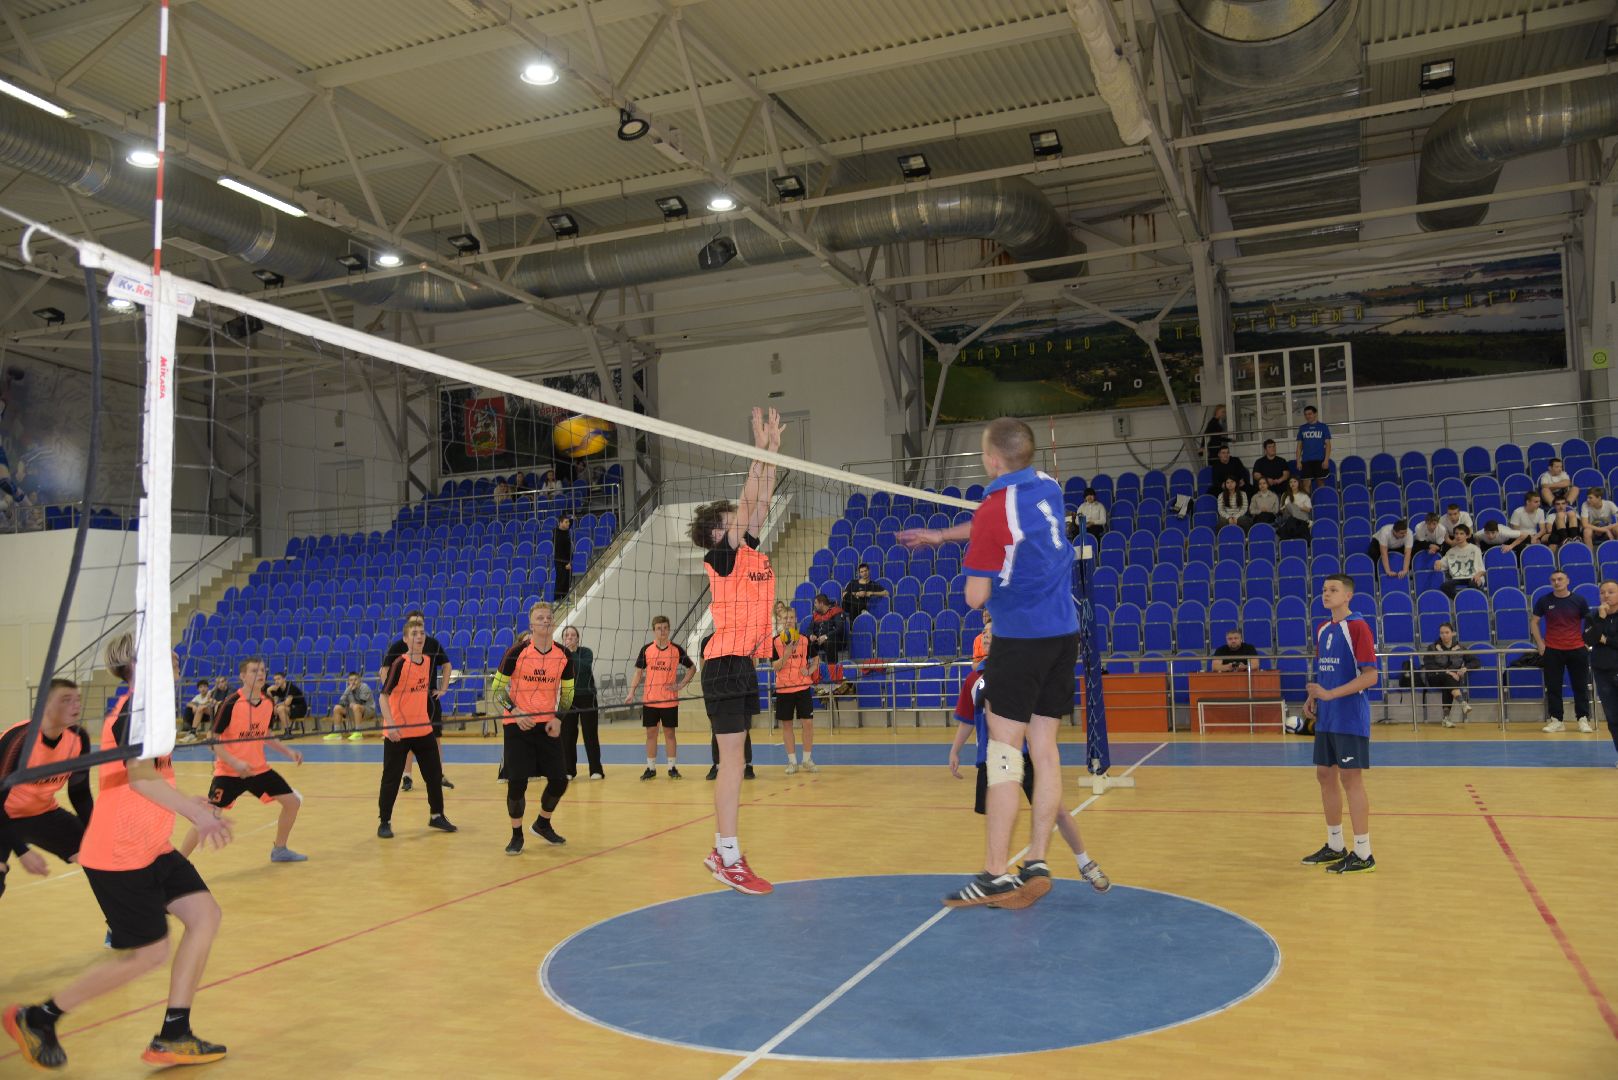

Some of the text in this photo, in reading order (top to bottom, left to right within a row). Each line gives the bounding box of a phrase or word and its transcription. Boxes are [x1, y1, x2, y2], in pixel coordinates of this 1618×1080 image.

[960, 289, 1517, 363] УЛЬТУРНО ПОТИВНЫЙ ЦЕНТР
[1325, 632, 1333, 650] 8
